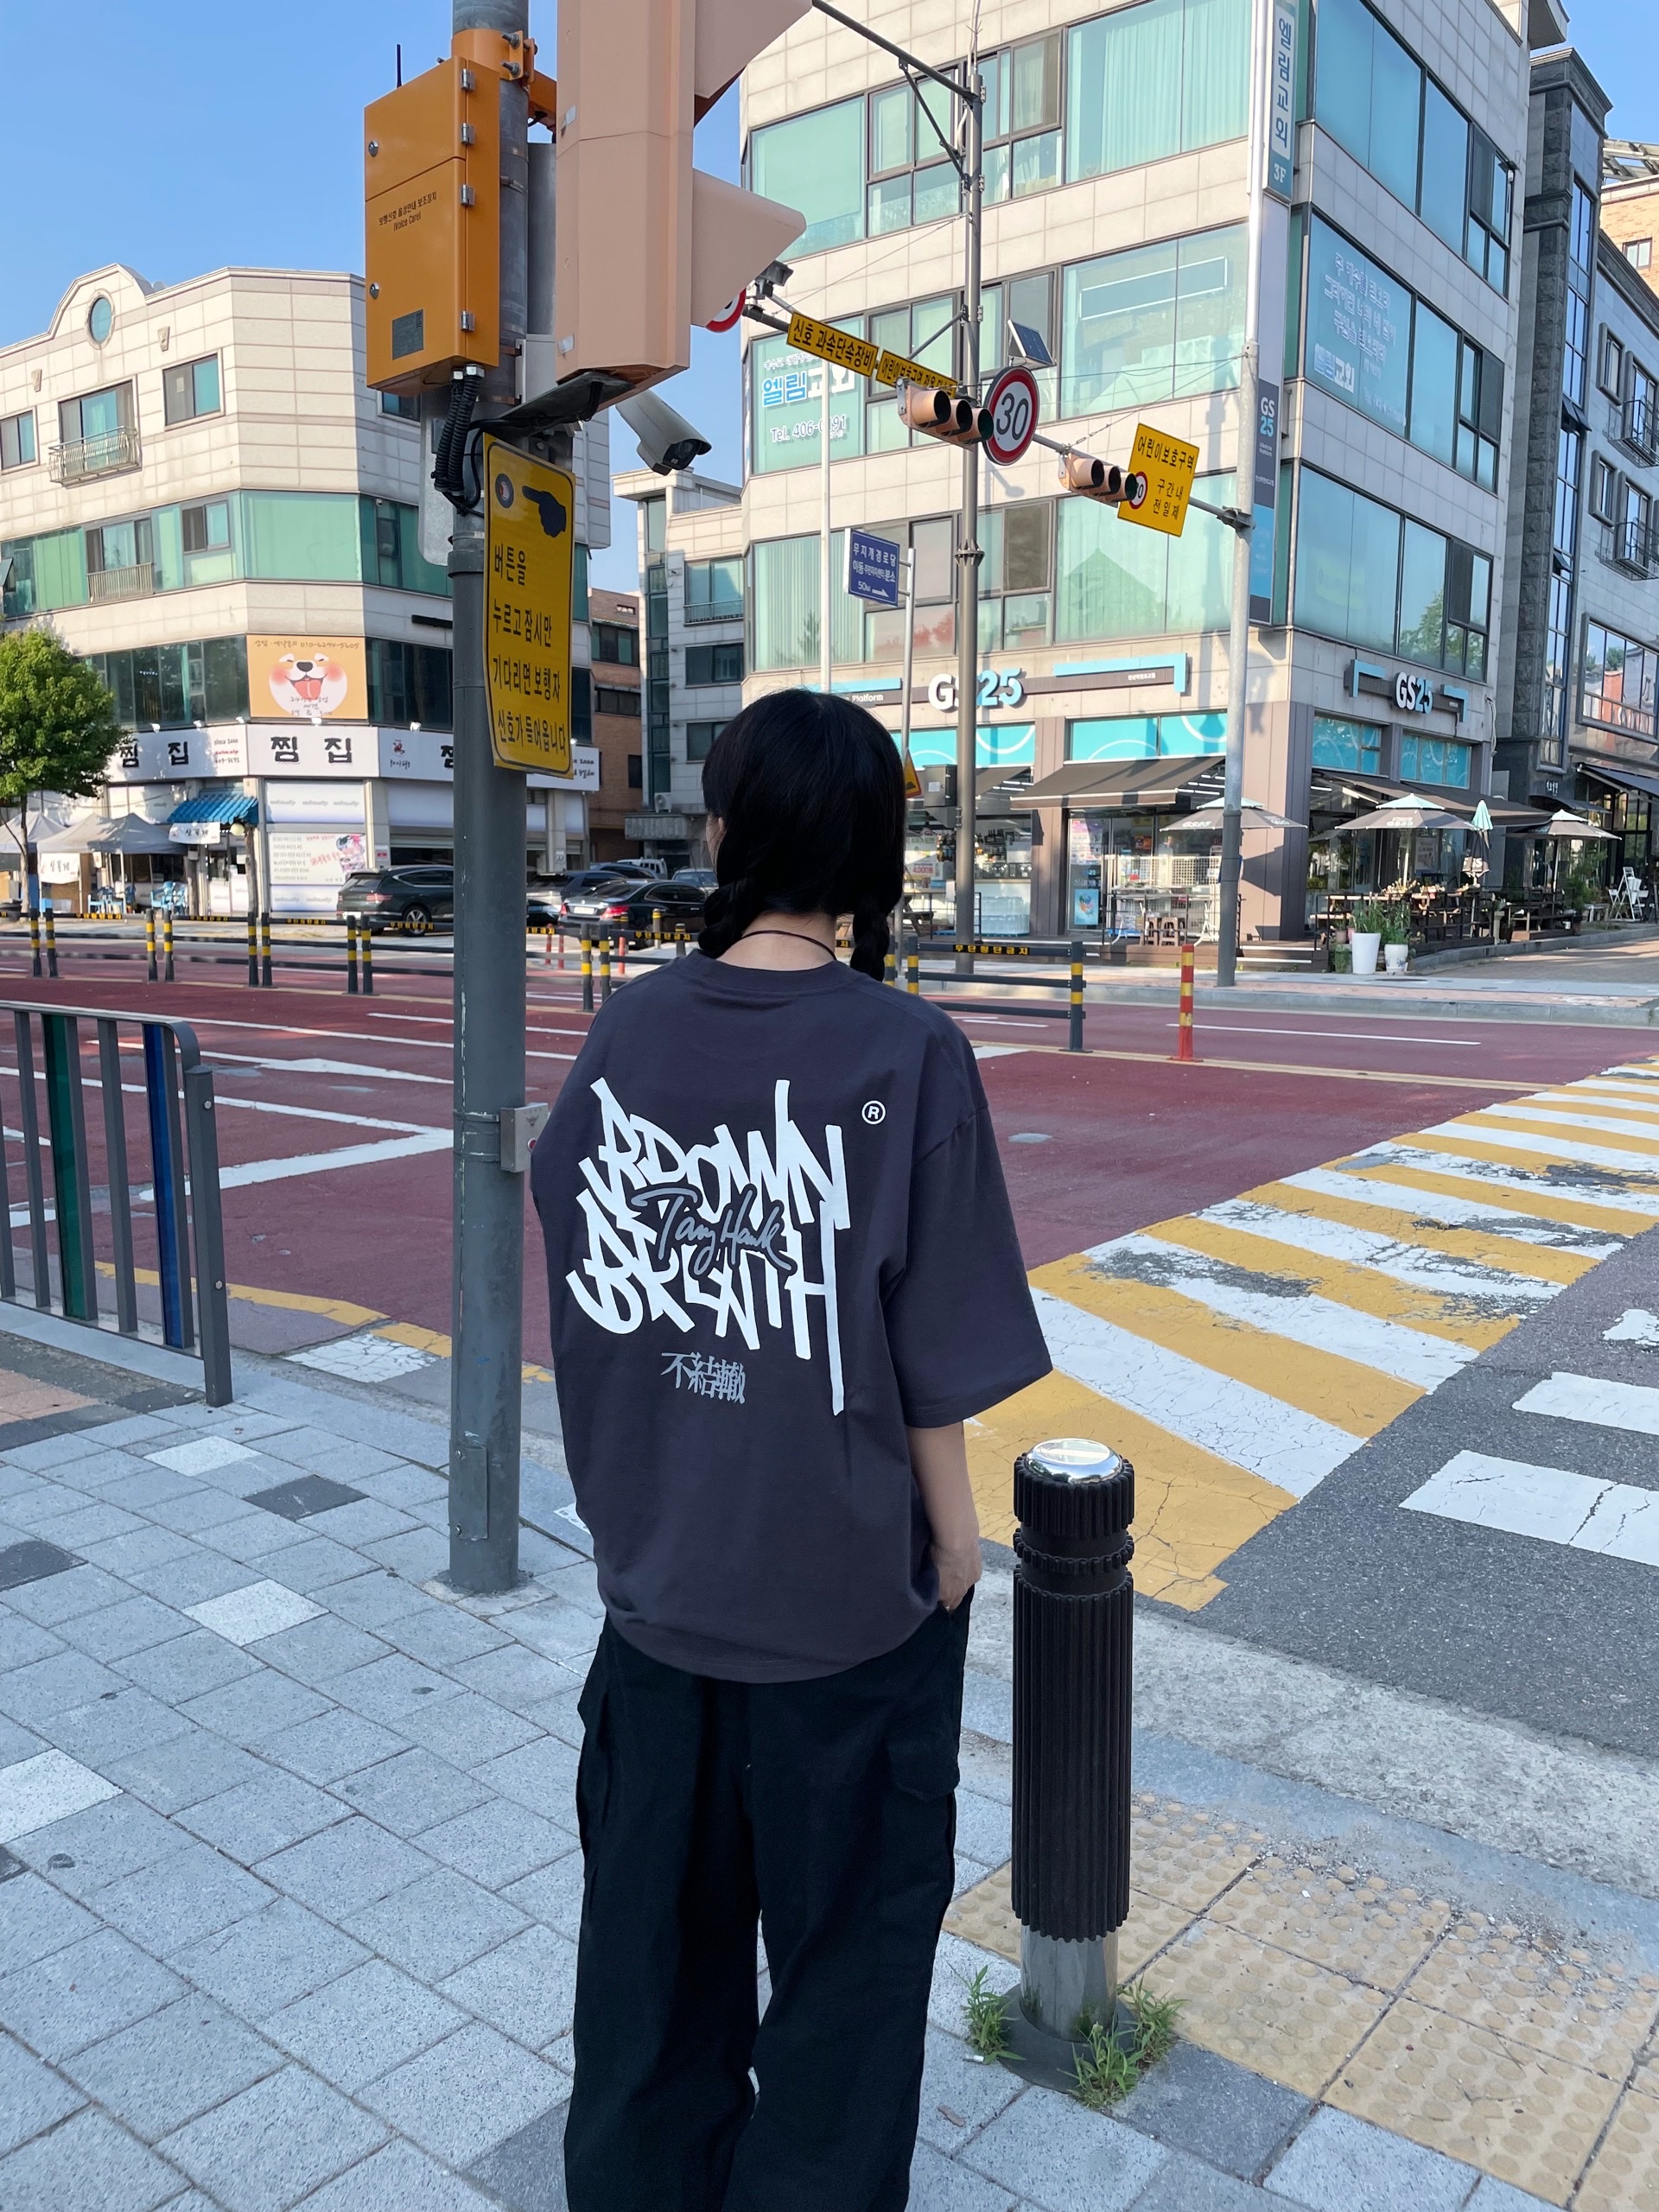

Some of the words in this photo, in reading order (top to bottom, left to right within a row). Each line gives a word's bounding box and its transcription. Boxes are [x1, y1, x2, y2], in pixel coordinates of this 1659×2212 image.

[1275, 17, 1292, 149] 엘림교회
[1274, 162, 1287, 183] 3F
[793, 319, 814, 346] 신호
[816, 329, 874, 372] 과속단속장비
[762, 365, 855, 408] 엘림교회
[1261, 397, 1274, 417] GS
[771, 426, 790, 442] Tel.
[995, 391, 1030, 436] 30
[1260, 415, 1274, 437] 25
[1137, 435, 1195, 475] 어린이보호구역
[493, 543, 527, 586] 버튼을
[493, 598, 522, 637] 누르고
[524, 607, 553, 648] 잠시만
[493, 654, 531, 696] 기다리면
[533, 665, 561, 704] 보행자
[928, 668, 1023, 711] G25
[1395, 671, 1433, 715] GS25
[270, 736, 353, 764] 찜집
[497, 708, 524, 748] 신호가
[525, 715, 567, 756] 들어옵니다
[955, 944, 1028, 956] 무단횡단금지
